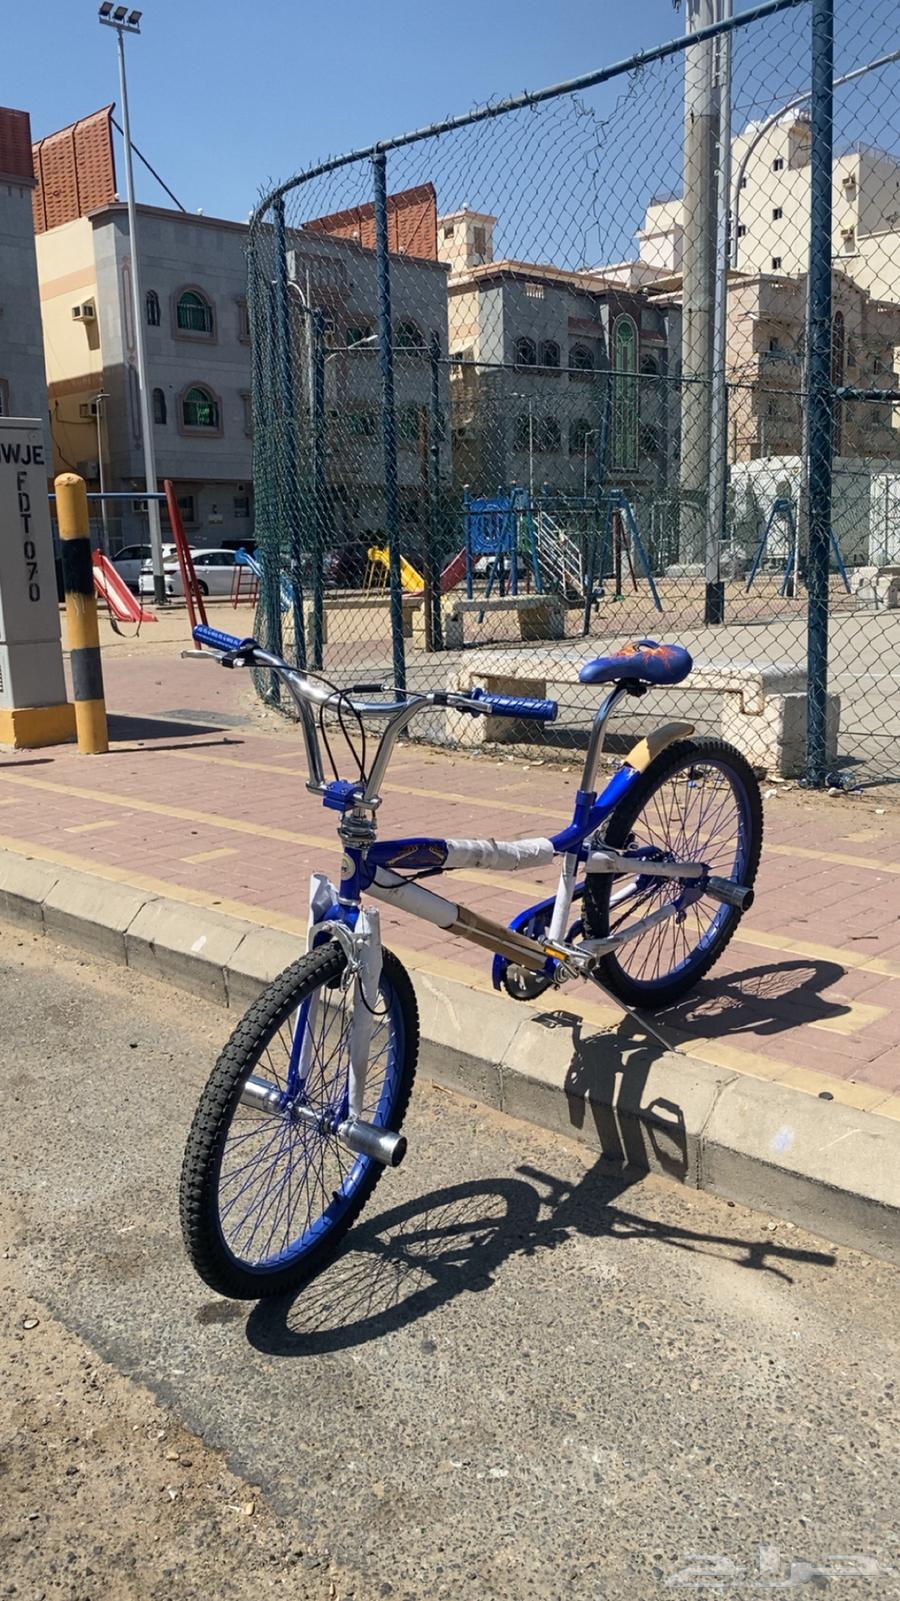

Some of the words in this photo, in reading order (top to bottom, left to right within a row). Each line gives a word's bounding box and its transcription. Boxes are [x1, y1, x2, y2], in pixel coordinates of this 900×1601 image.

[0, 443, 45, 465] WJE
[16, 471, 32, 534] FDT
[23, 540, 41, 602] 070
